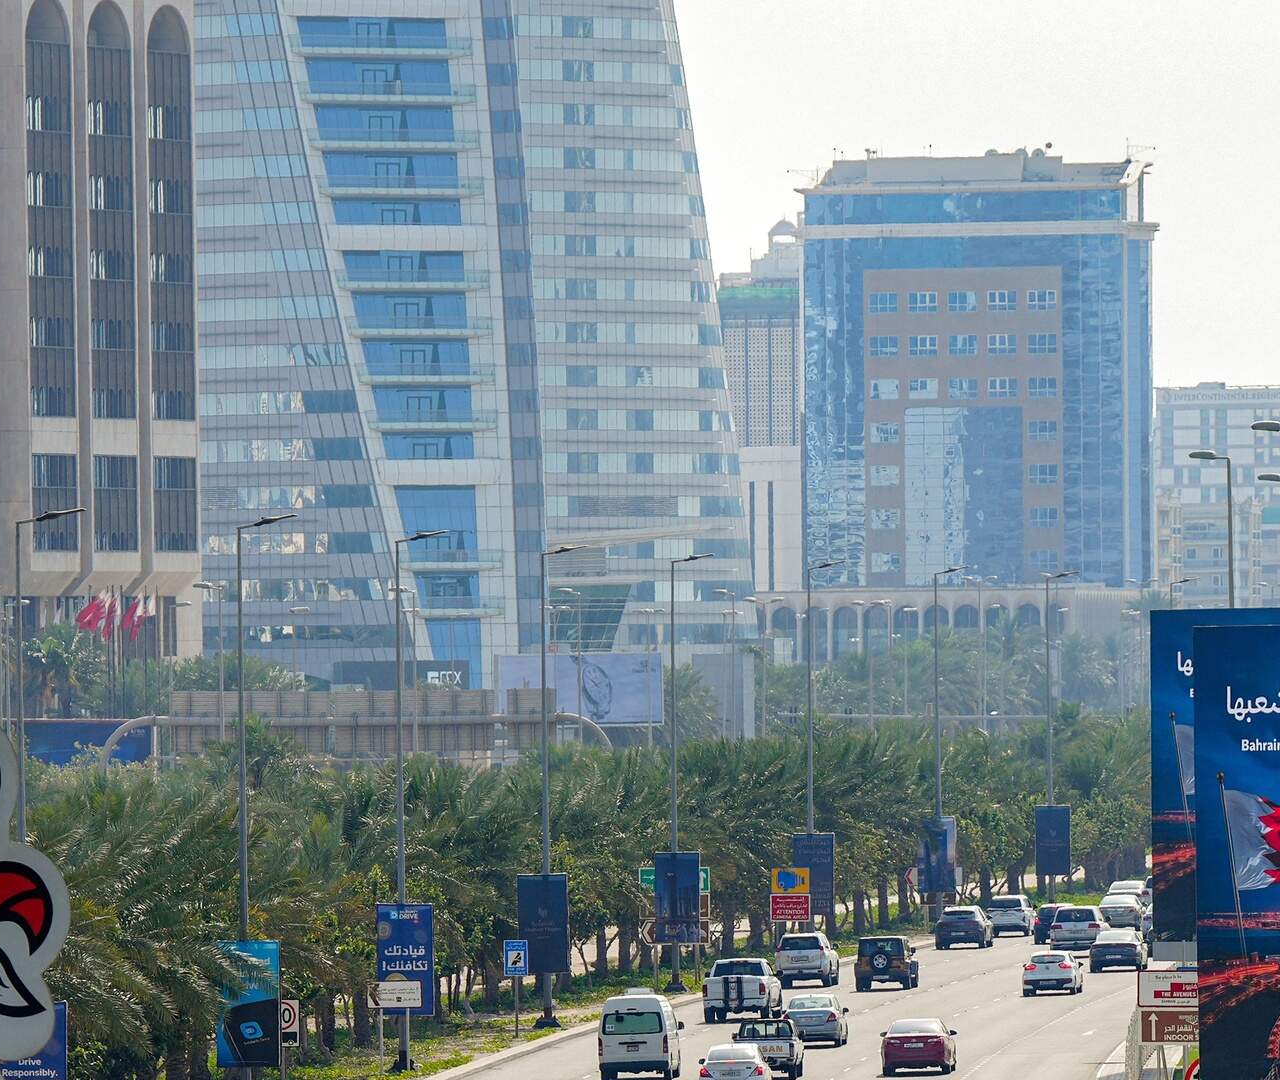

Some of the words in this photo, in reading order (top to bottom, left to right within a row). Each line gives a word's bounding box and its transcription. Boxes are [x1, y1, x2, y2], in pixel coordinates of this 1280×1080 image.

[384, 944, 425, 958] قيادتك
[18, 1058, 42, 1066] Drive
[1, 1068, 59, 1079] Responsibly.
